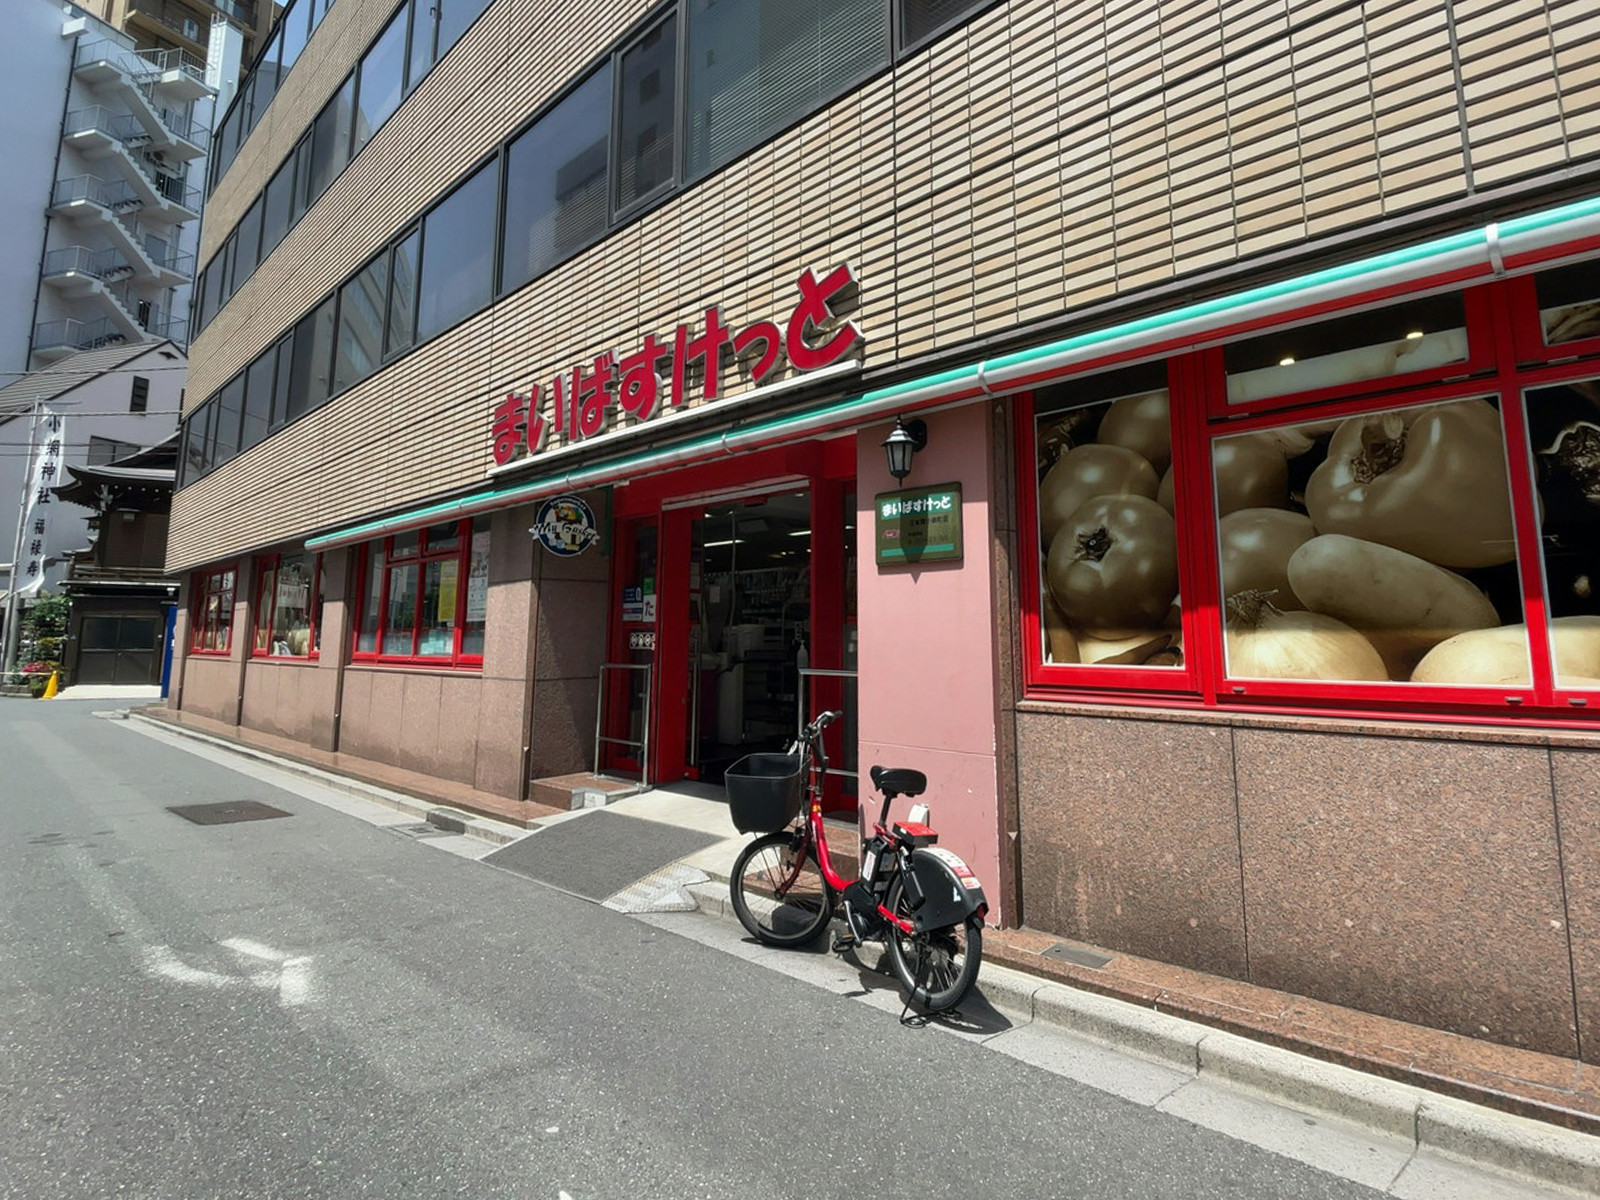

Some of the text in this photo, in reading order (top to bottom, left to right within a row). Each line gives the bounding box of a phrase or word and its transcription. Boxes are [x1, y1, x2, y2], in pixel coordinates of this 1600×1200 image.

[491, 260, 864, 466] まいばすけっと
[37, 415, 61, 505] 小網神社
[882, 495, 951, 517] まいばすけっと
